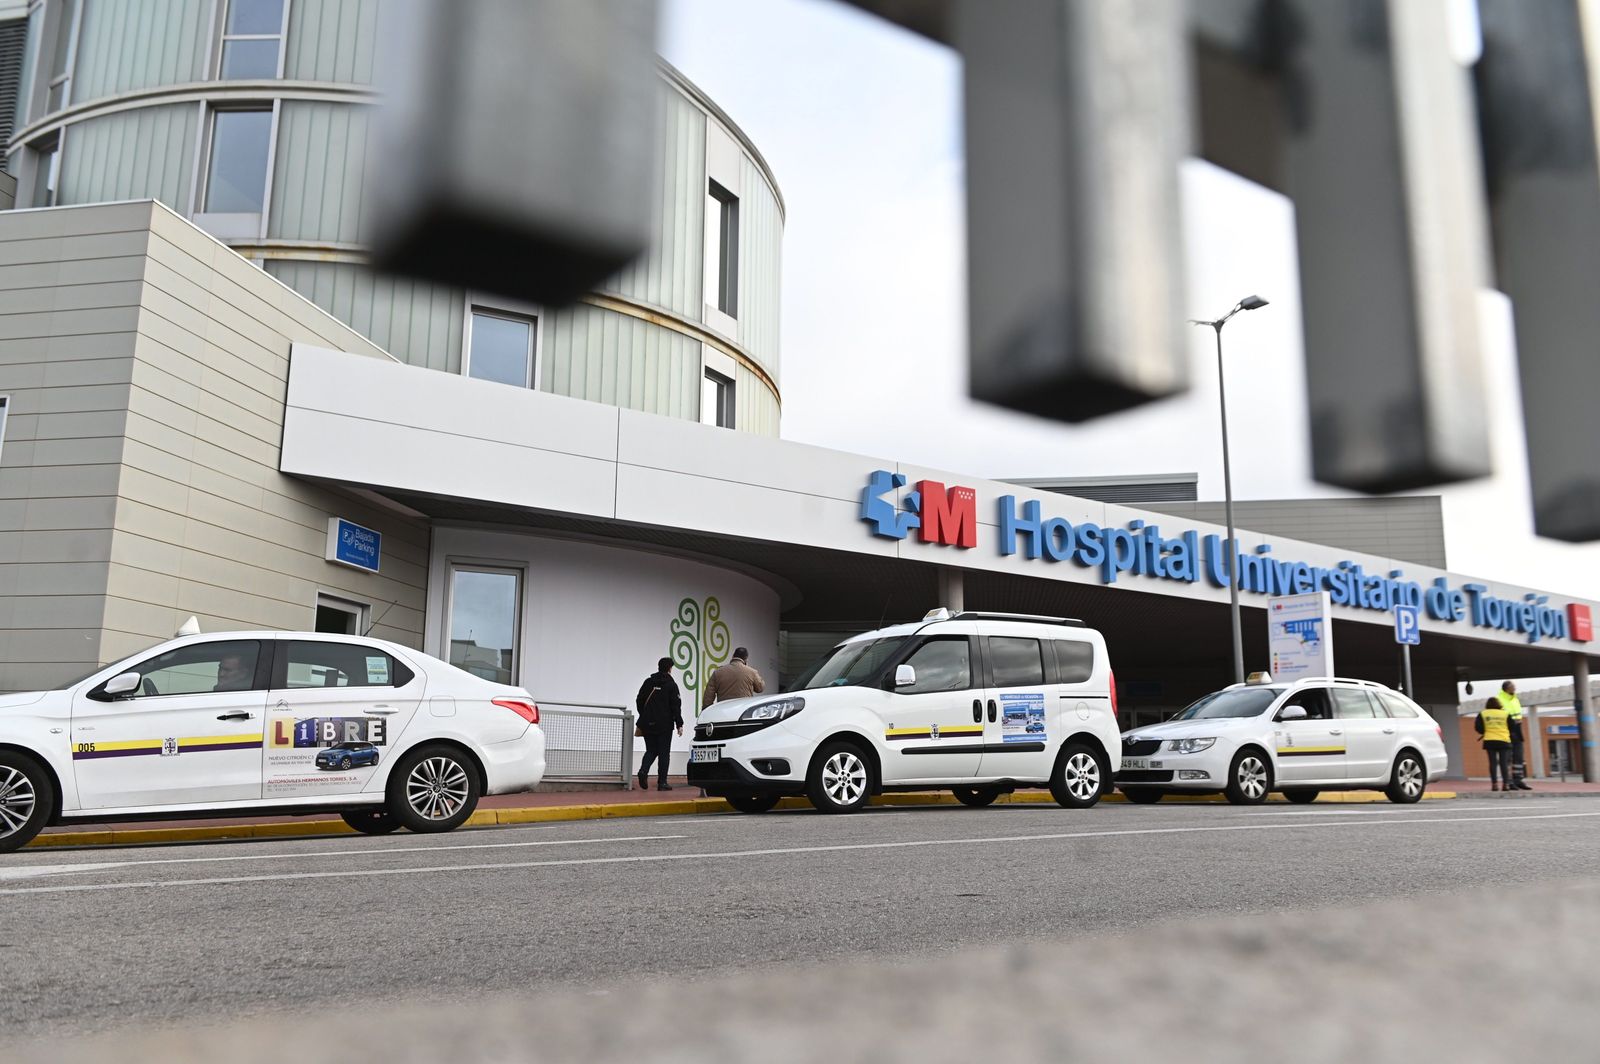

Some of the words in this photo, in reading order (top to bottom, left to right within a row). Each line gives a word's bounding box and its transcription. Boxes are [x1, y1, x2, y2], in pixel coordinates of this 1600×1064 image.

[917, 480, 976, 548] M
[355, 529, 374, 543] Bajada
[354, 540, 375, 556] Parking
[999, 494, 1200, 584] Hospital
[1204, 534, 1424, 615] Universitario
[1425, 577, 1466, 622] de
[1463, 583, 1567, 643] Torrejón
[1400, 610, 1415, 639] P
[78, 743, 95, 752] 005
